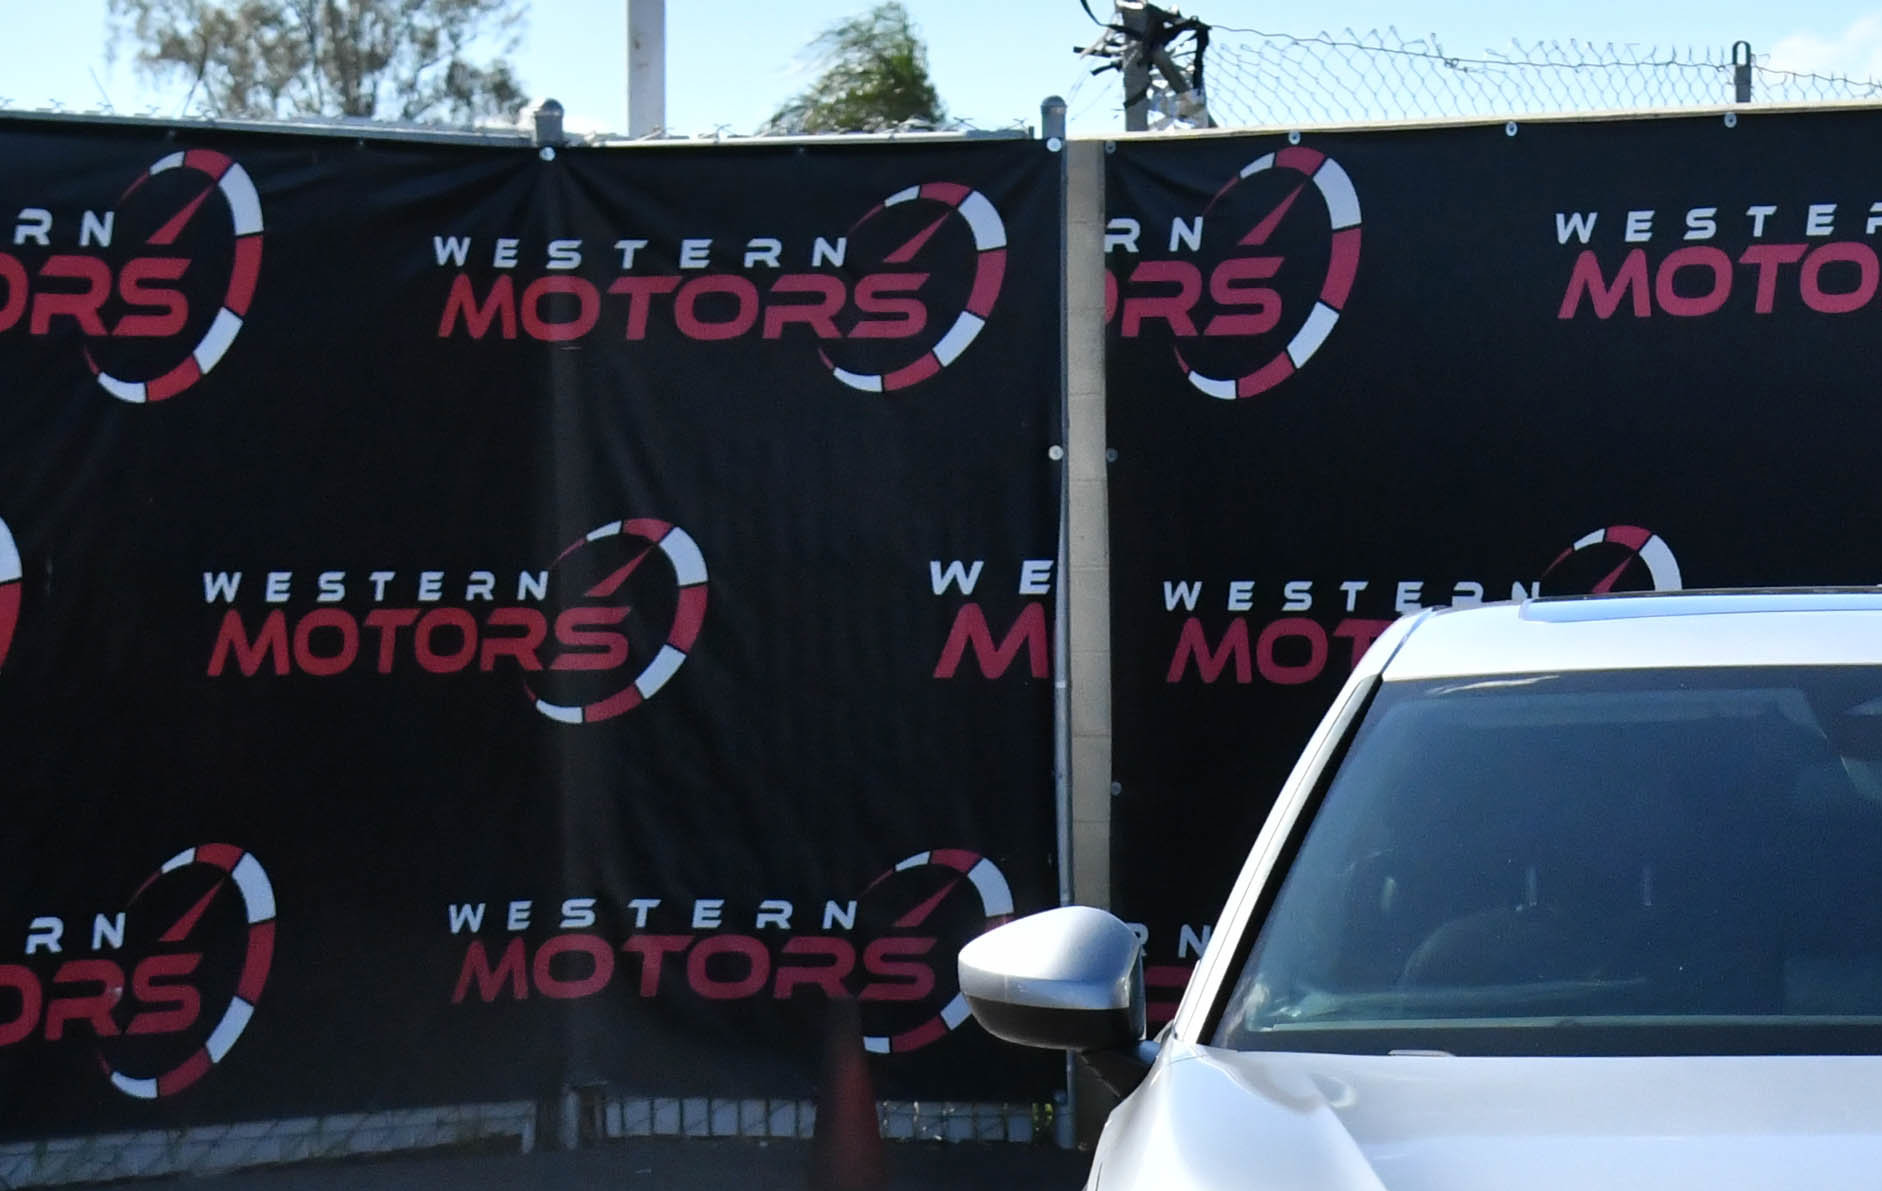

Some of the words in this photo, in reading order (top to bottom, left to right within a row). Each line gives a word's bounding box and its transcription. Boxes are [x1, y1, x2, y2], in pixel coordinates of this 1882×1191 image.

[434, 236, 847, 270] WESTERN
[437, 272, 929, 342] MOTORS
[1104, 256, 1285, 337] RS
[203, 570, 549, 602] WESTERN
[206, 606, 630, 677] MOTORS
[449, 899, 857, 934] WESTERN
[452, 934, 936, 1003] MOTORS
